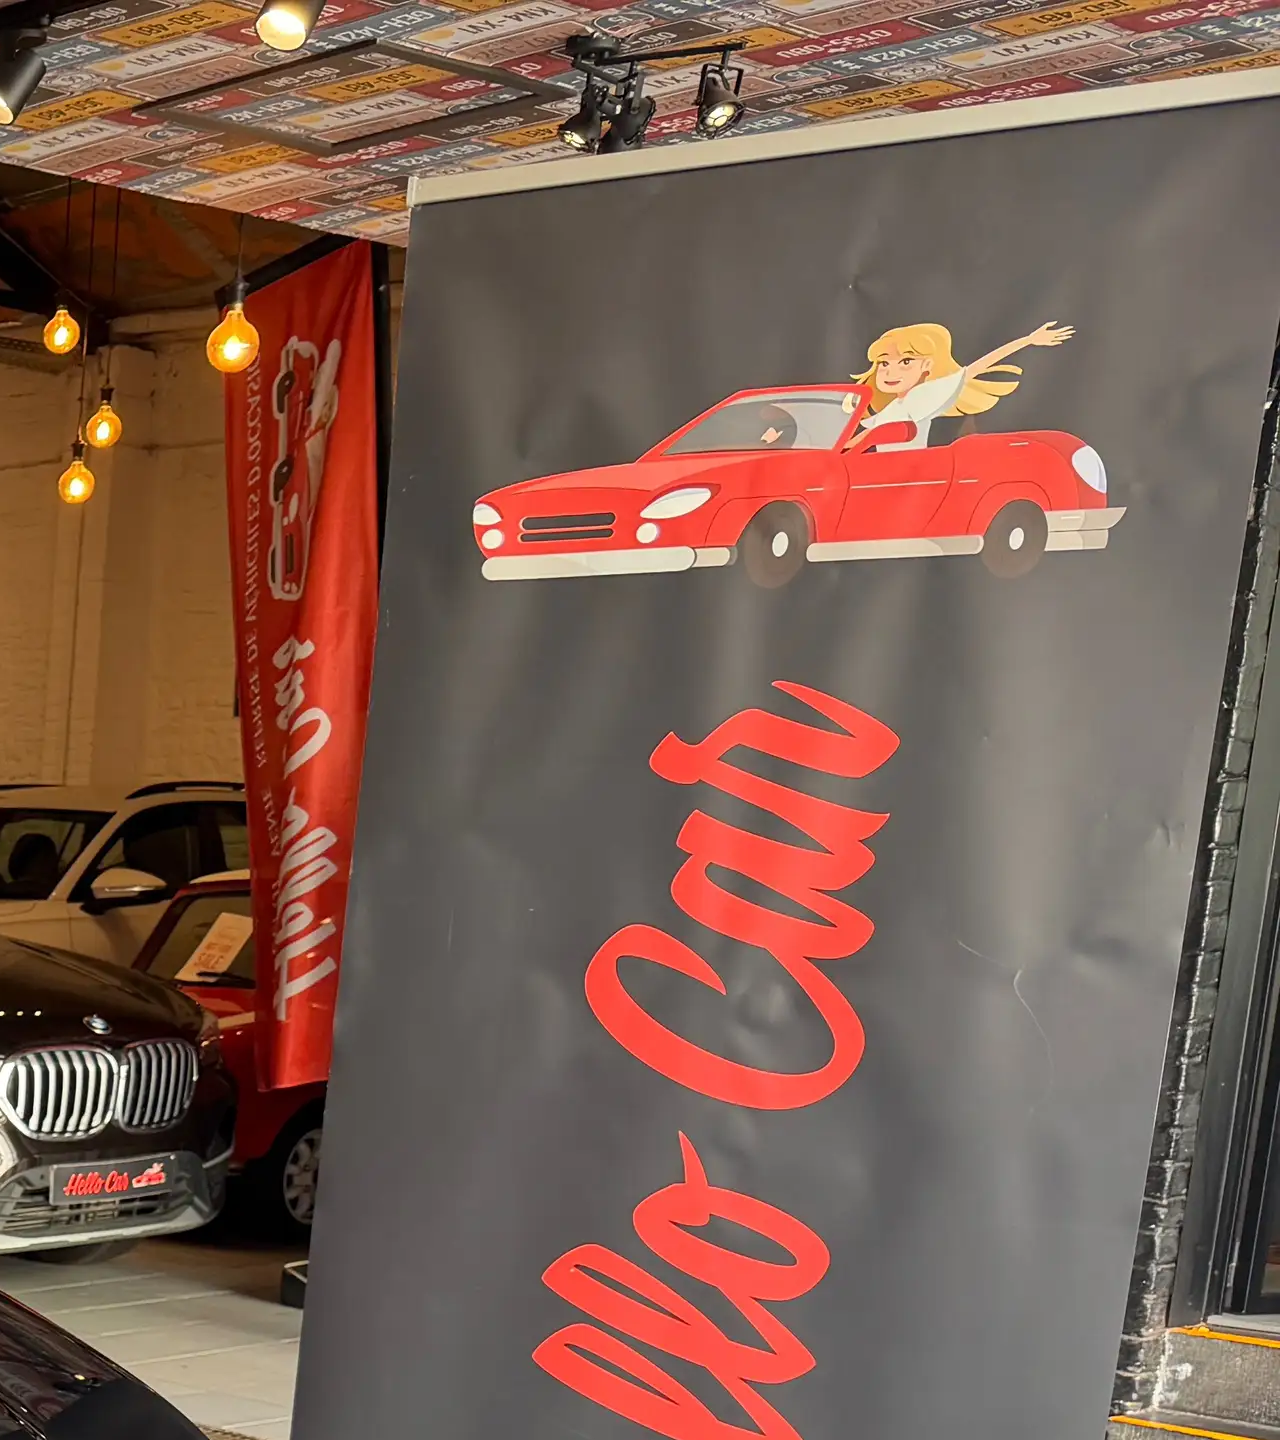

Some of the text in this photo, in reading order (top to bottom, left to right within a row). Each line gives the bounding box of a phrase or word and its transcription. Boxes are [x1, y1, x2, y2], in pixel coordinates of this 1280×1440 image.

[584, 680, 901, 1111] Car
[63, 1170, 129, 1196] Hello Car
